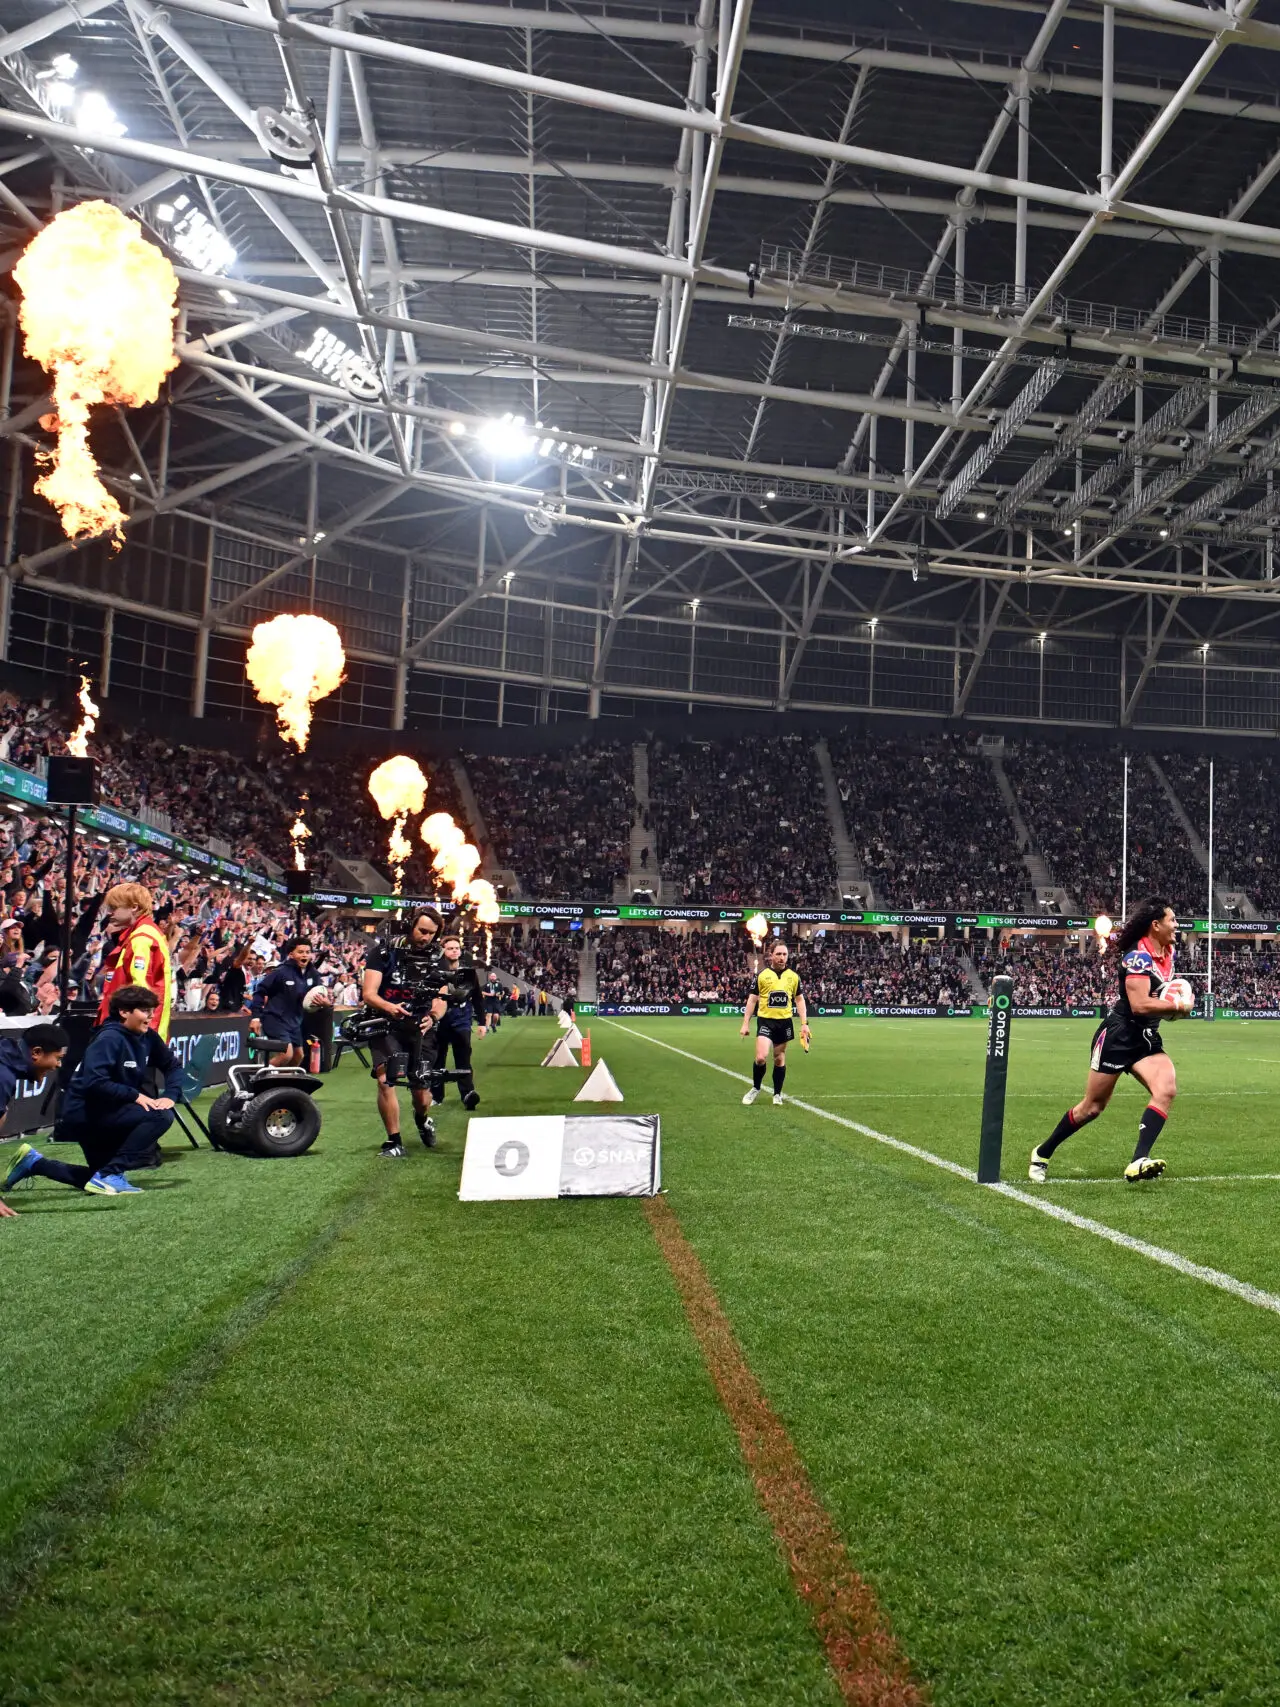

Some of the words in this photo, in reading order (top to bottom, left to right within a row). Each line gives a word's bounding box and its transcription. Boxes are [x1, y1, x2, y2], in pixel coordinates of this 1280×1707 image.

[1127, 955, 1149, 970] sky
[771, 996, 786, 1004] youi
[995, 1011, 1006, 1056] one.nz
[597, 1151, 648, 1163] SNAP
